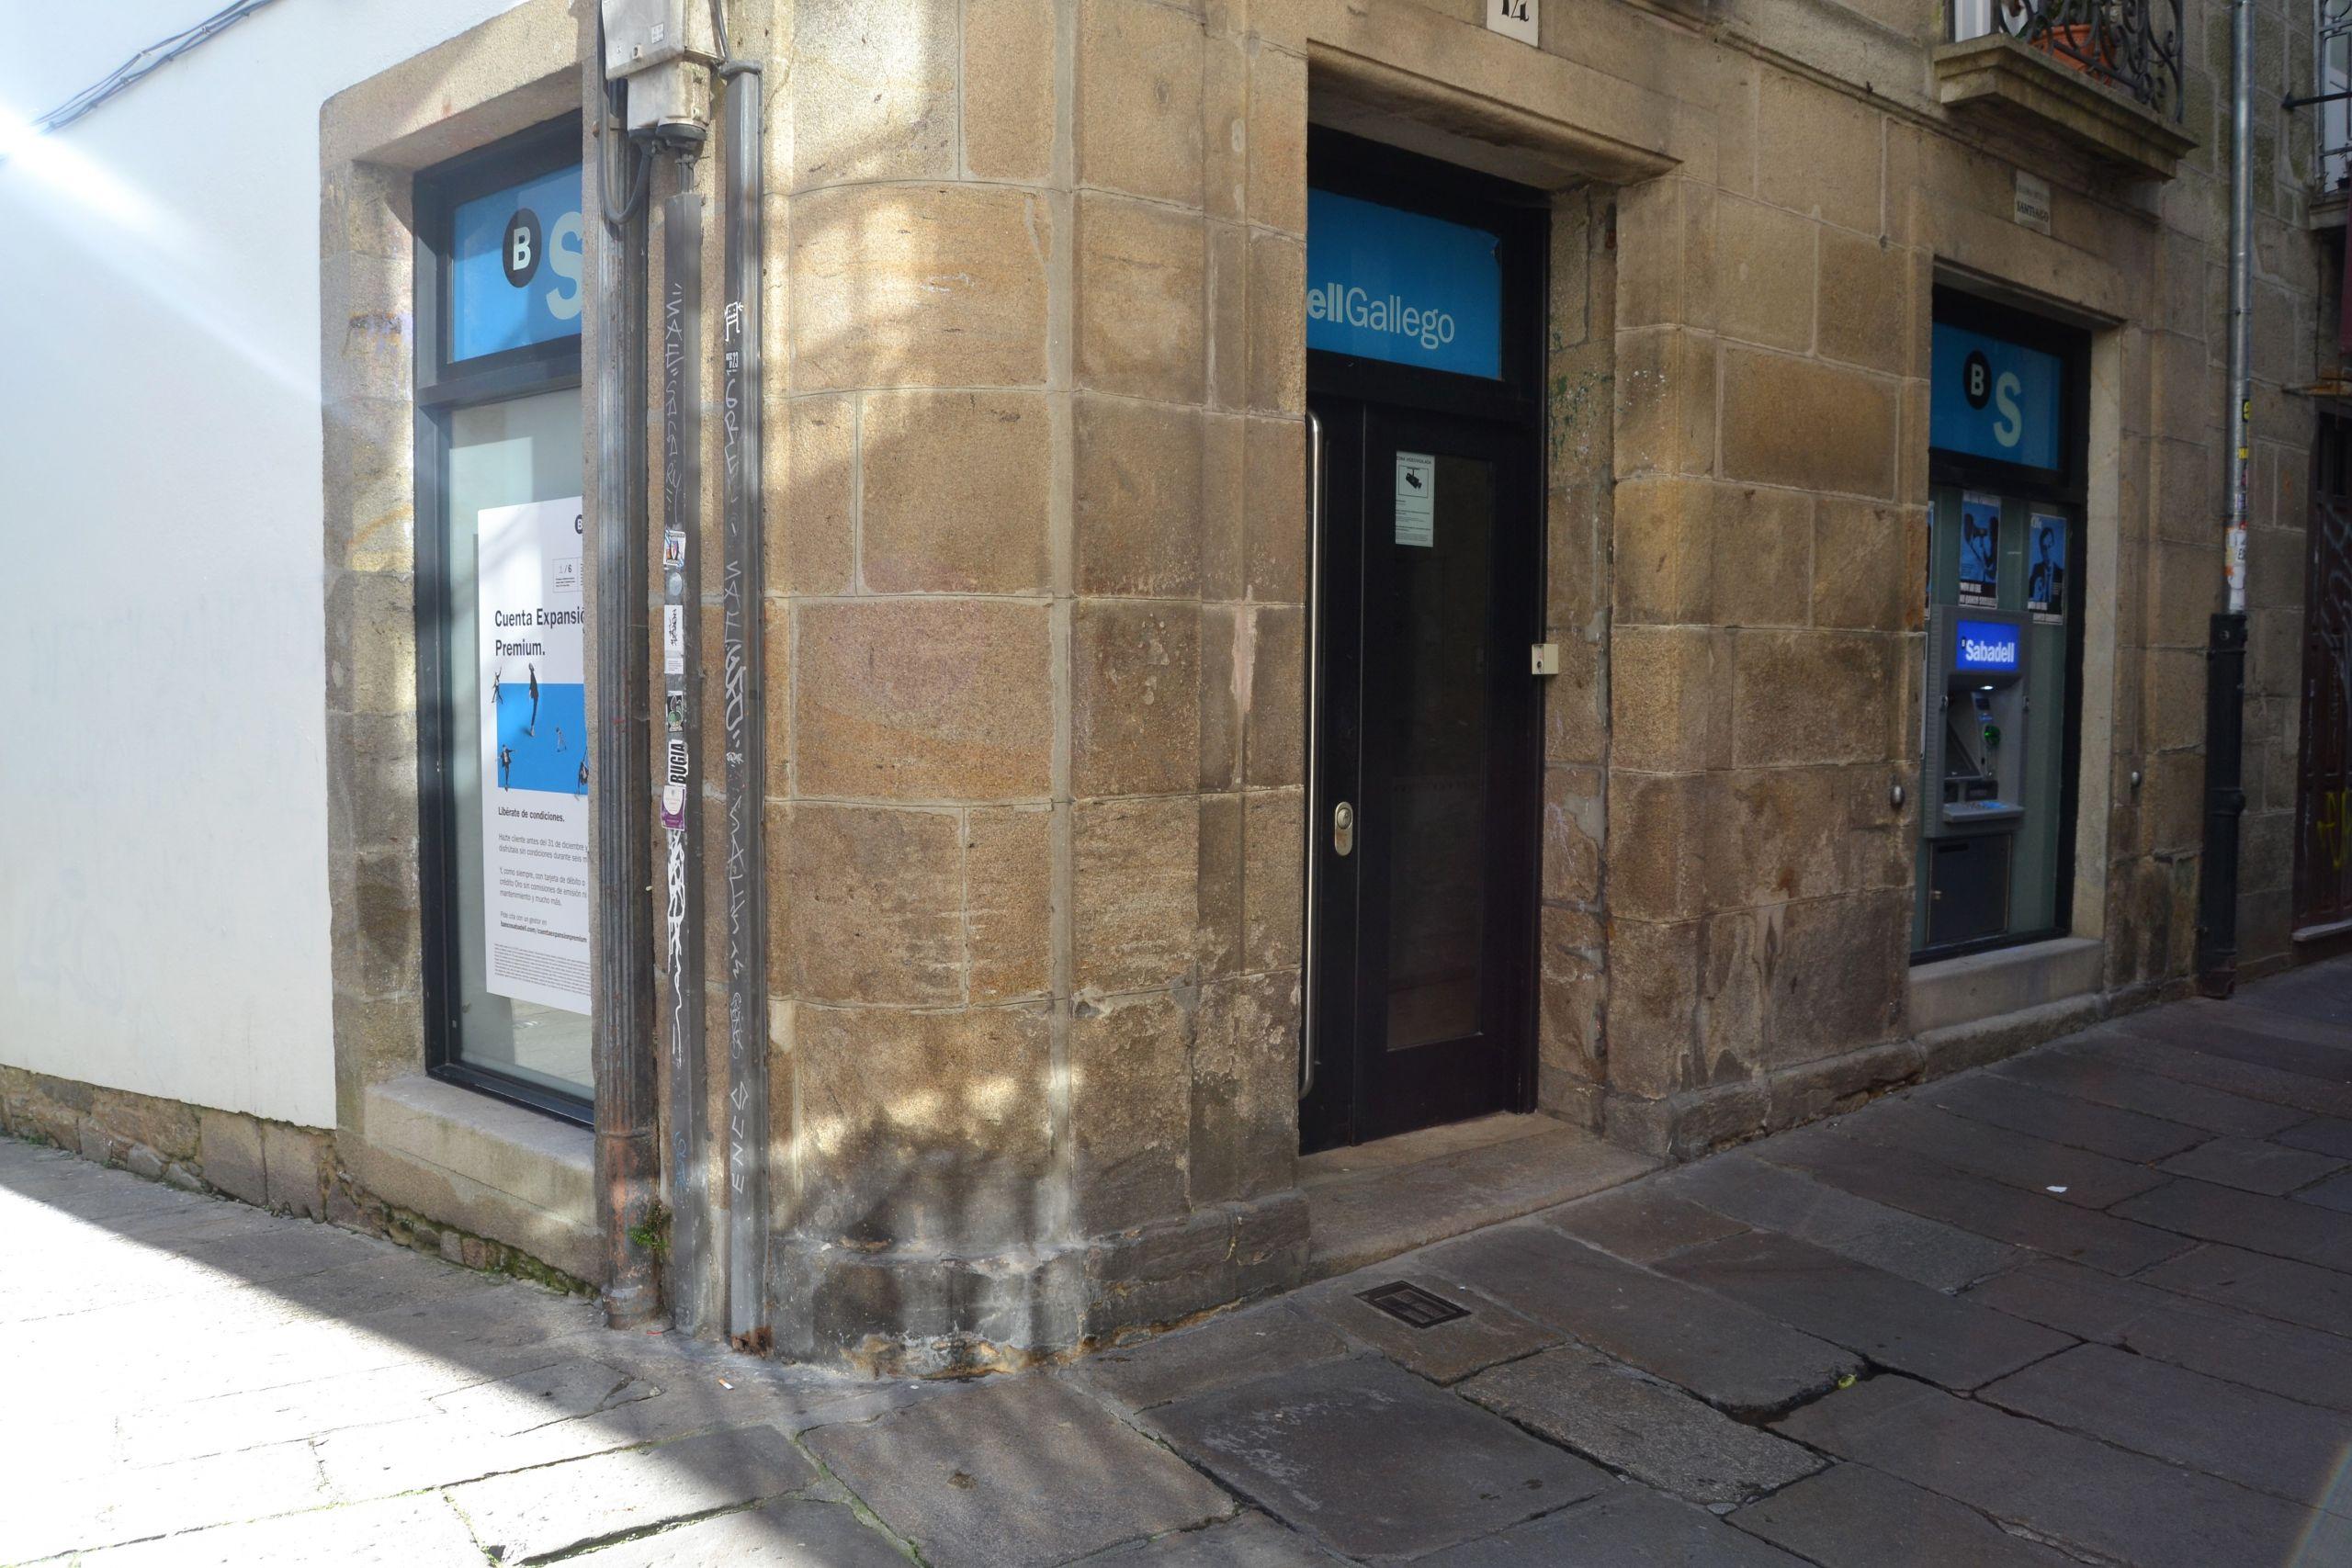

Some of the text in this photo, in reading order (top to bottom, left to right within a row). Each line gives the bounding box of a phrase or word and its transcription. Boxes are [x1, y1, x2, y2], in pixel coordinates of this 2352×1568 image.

[513, 212, 582, 320] B S
[1306, 282, 1455, 350] ellGallego
[1971, 363, 2022, 448] B S
[495, 609, 532, 627] Cuenta
[495, 639, 546, 656] Premium.
[1965, 638, 2015, 663] Sabadell
[670, 742, 689, 784] BUGIA
[498, 807, 520, 817] Libérate
[530, 811, 565, 822] condiciones.
